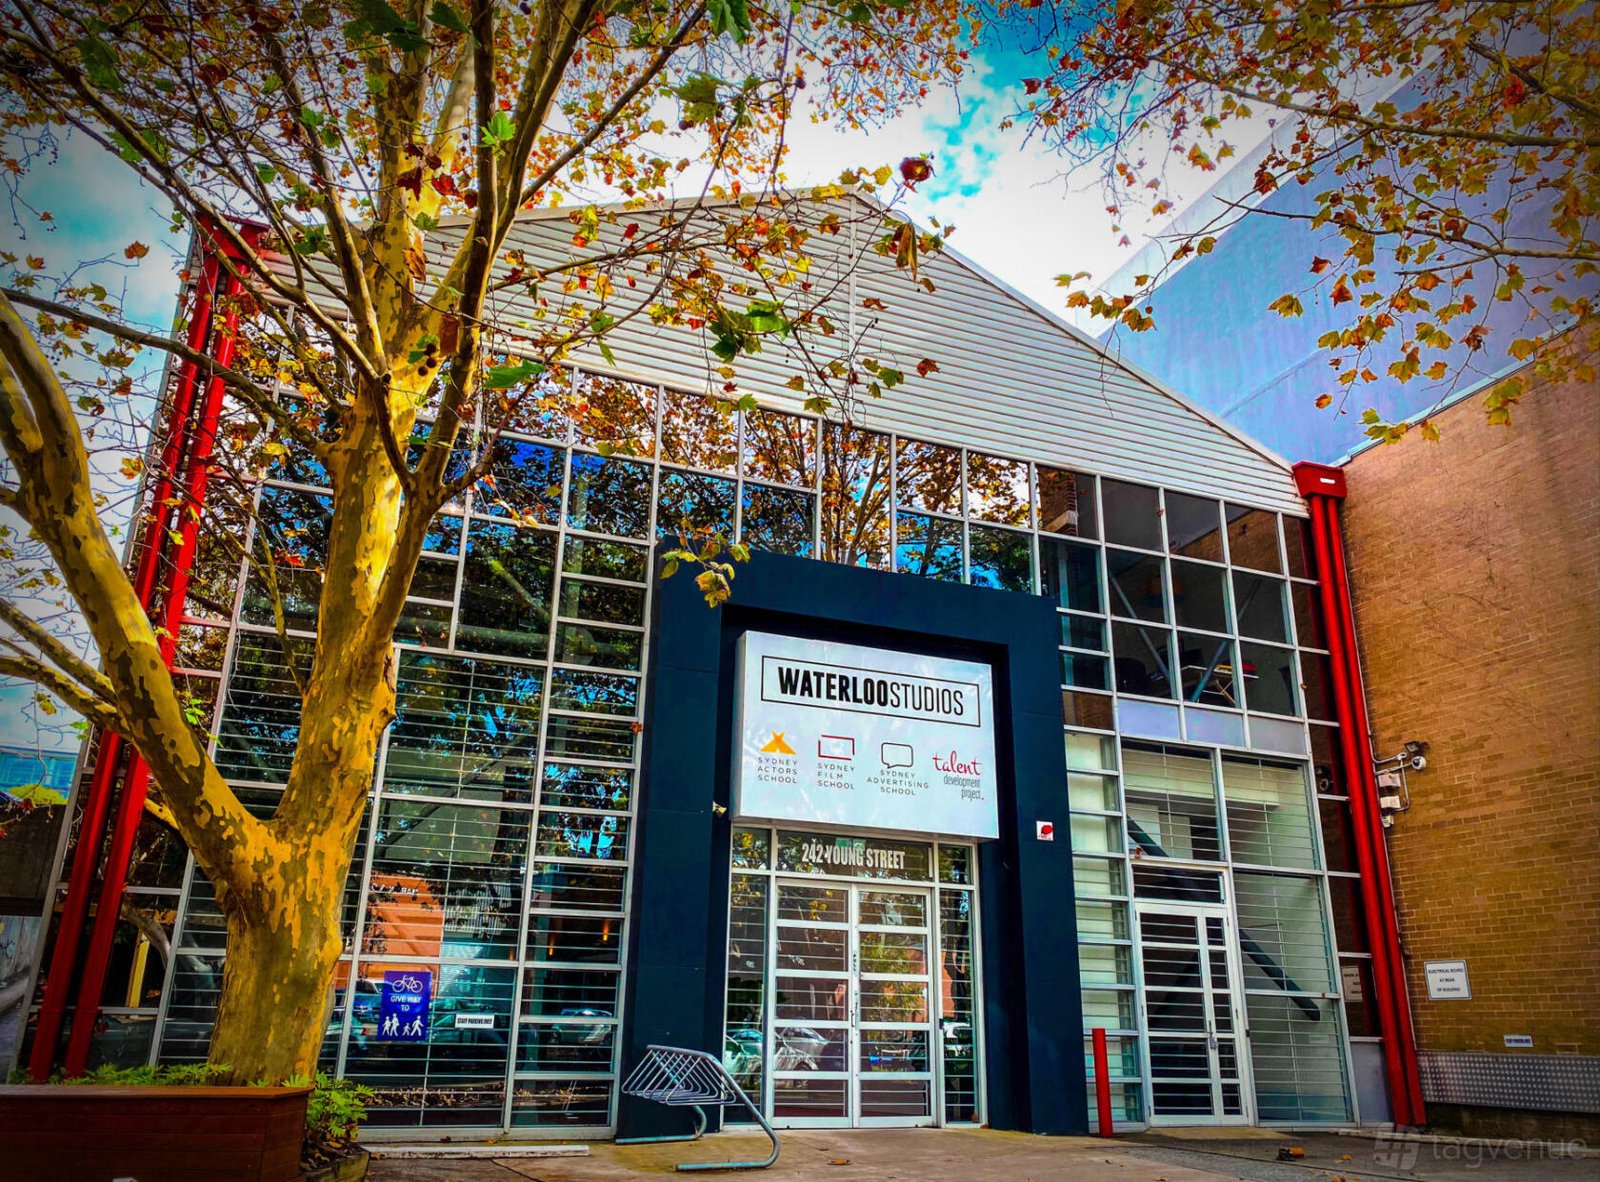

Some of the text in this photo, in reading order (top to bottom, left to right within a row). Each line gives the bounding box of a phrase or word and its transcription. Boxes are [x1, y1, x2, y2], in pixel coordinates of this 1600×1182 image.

[778, 666, 964, 716] WATERLOOSTUDIOS
[758, 757, 797, 766] SYDNEY
[932, 750, 983, 776] talent
[757, 766, 797, 775] ACTORS
[818, 763, 855, 772] SYDNEY
[818, 771, 843, 779] FILM
[880, 769, 916, 778] SYDNEY
[758, 775, 797, 784] SCHOOL
[867, 777, 929, 789] ADVERTISING
[943, 774, 981, 788] development
[818, 780, 855, 789] SCHOOL
[880, 786, 916, 796] SCHOOL
[802, 843, 905, 870] 242 YOUNG STREET
[390, 995, 422, 1003] GIVE WAY
